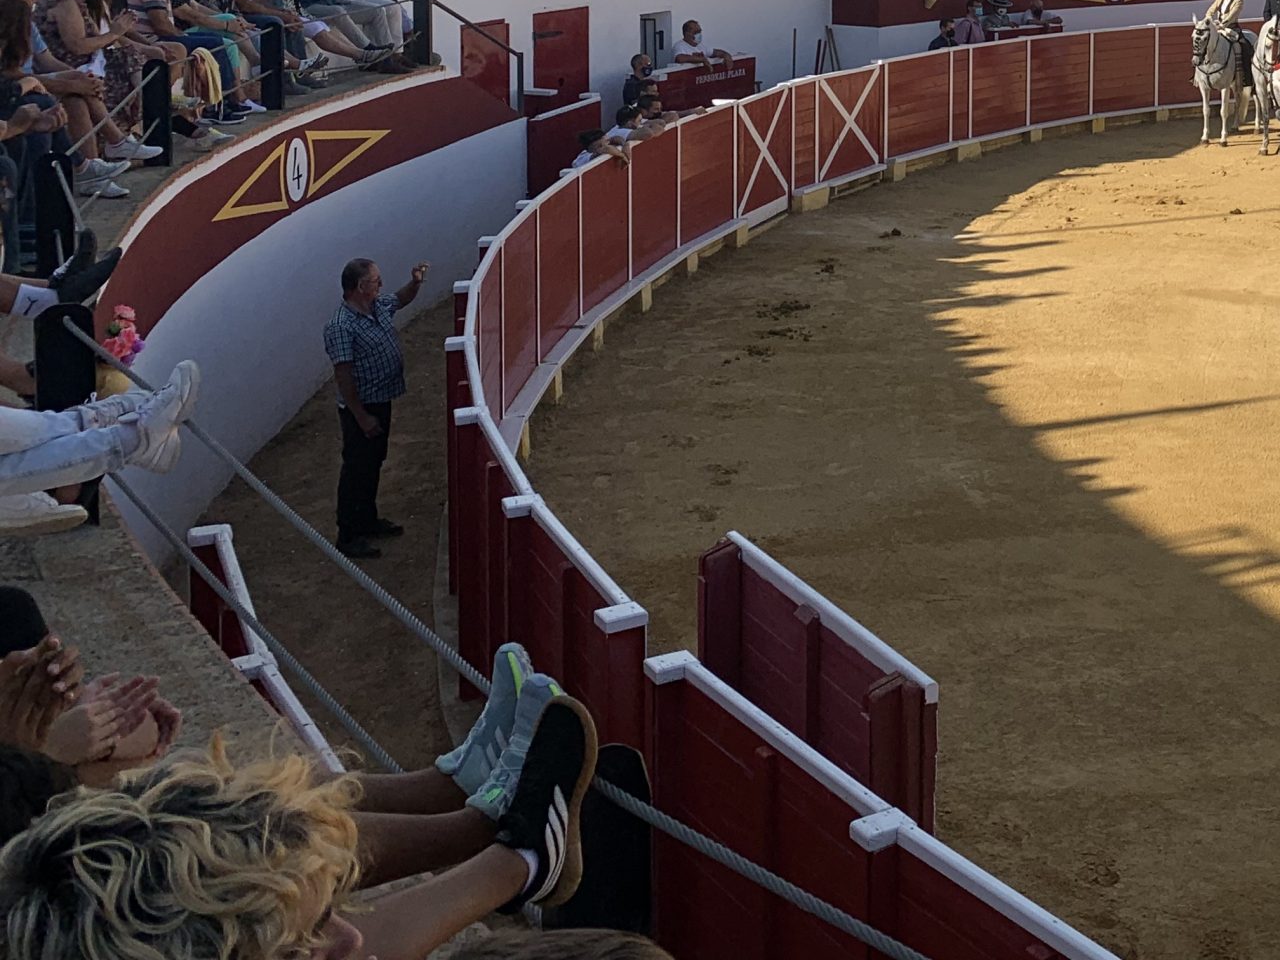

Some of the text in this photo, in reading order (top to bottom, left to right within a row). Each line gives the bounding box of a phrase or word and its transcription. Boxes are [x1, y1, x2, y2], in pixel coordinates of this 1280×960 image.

[695, 68, 746, 85] PERSONAL PLAZA
[292, 147, 303, 190] 4
